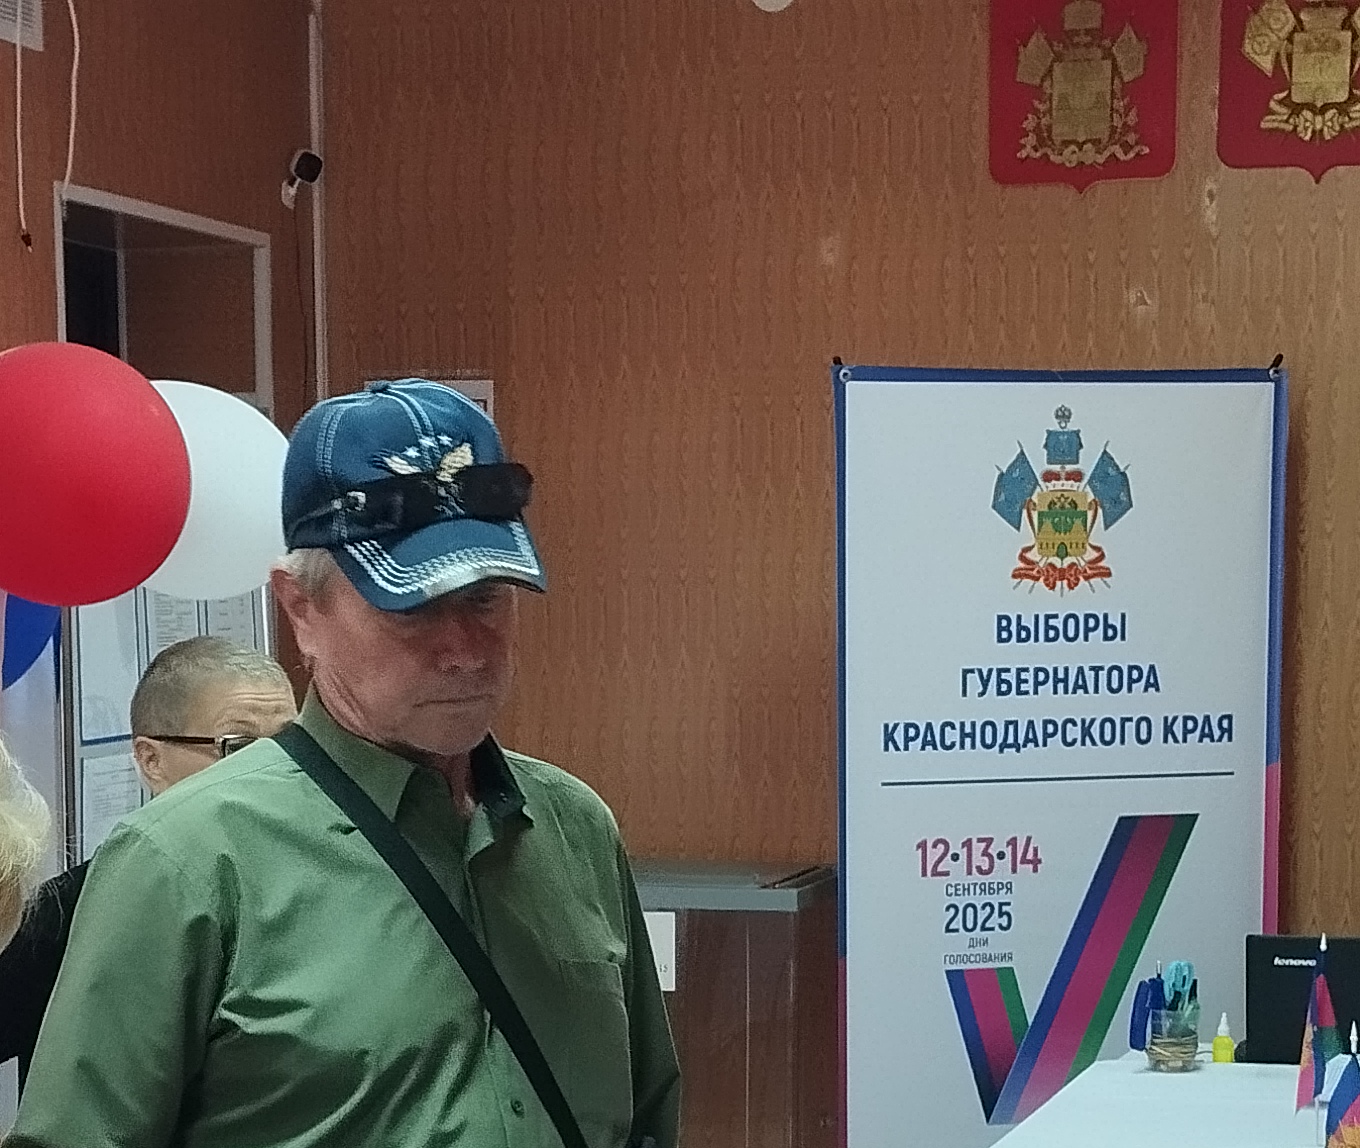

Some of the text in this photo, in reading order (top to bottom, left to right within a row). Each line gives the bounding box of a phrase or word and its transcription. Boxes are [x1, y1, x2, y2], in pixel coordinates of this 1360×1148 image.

[995, 612, 1128, 645] ВЫБОРЫ
[960, 663, 1162, 698] ГУБЕРНАТОРА
[882, 713, 1234, 755] КРАСНОДАРСКОГО КРАЯ
[945, 881, 1014, 897] СЕНТЯБРЯ
[944, 901, 1013, 934] 2025
[943, 952, 1014, 966] ГОЛОСОВАНИЯ
[967, 937, 989, 949] ДНИ
